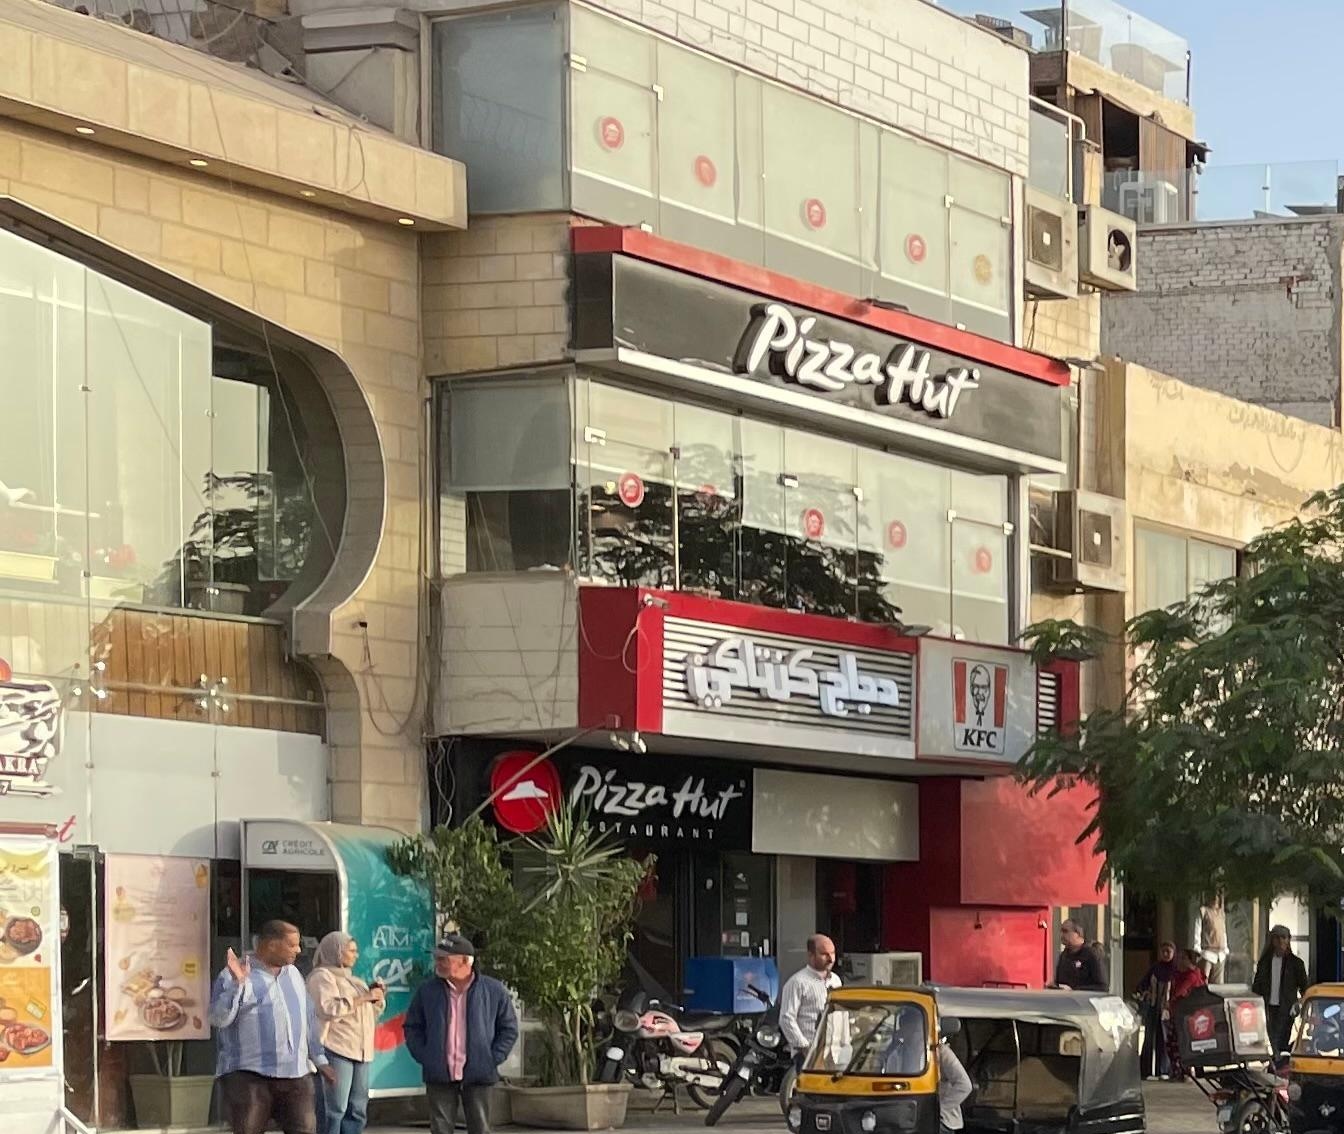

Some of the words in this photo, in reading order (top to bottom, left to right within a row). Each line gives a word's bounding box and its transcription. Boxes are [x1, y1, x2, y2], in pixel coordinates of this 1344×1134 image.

[747, 303, 884, 391] Pizza
[886, 344, 979, 418] Hut
[819, 653, 900, 717] دجاج
[963, 728, 998, 749] KFC
[0, 755, 40, 775] KRA
[572, 765, 669, 816] Pizza
[672, 775, 743, 821] Hut
[582, 820, 714, 840] ESTAURANT
[282, 848, 325, 856] AGRICOLE
